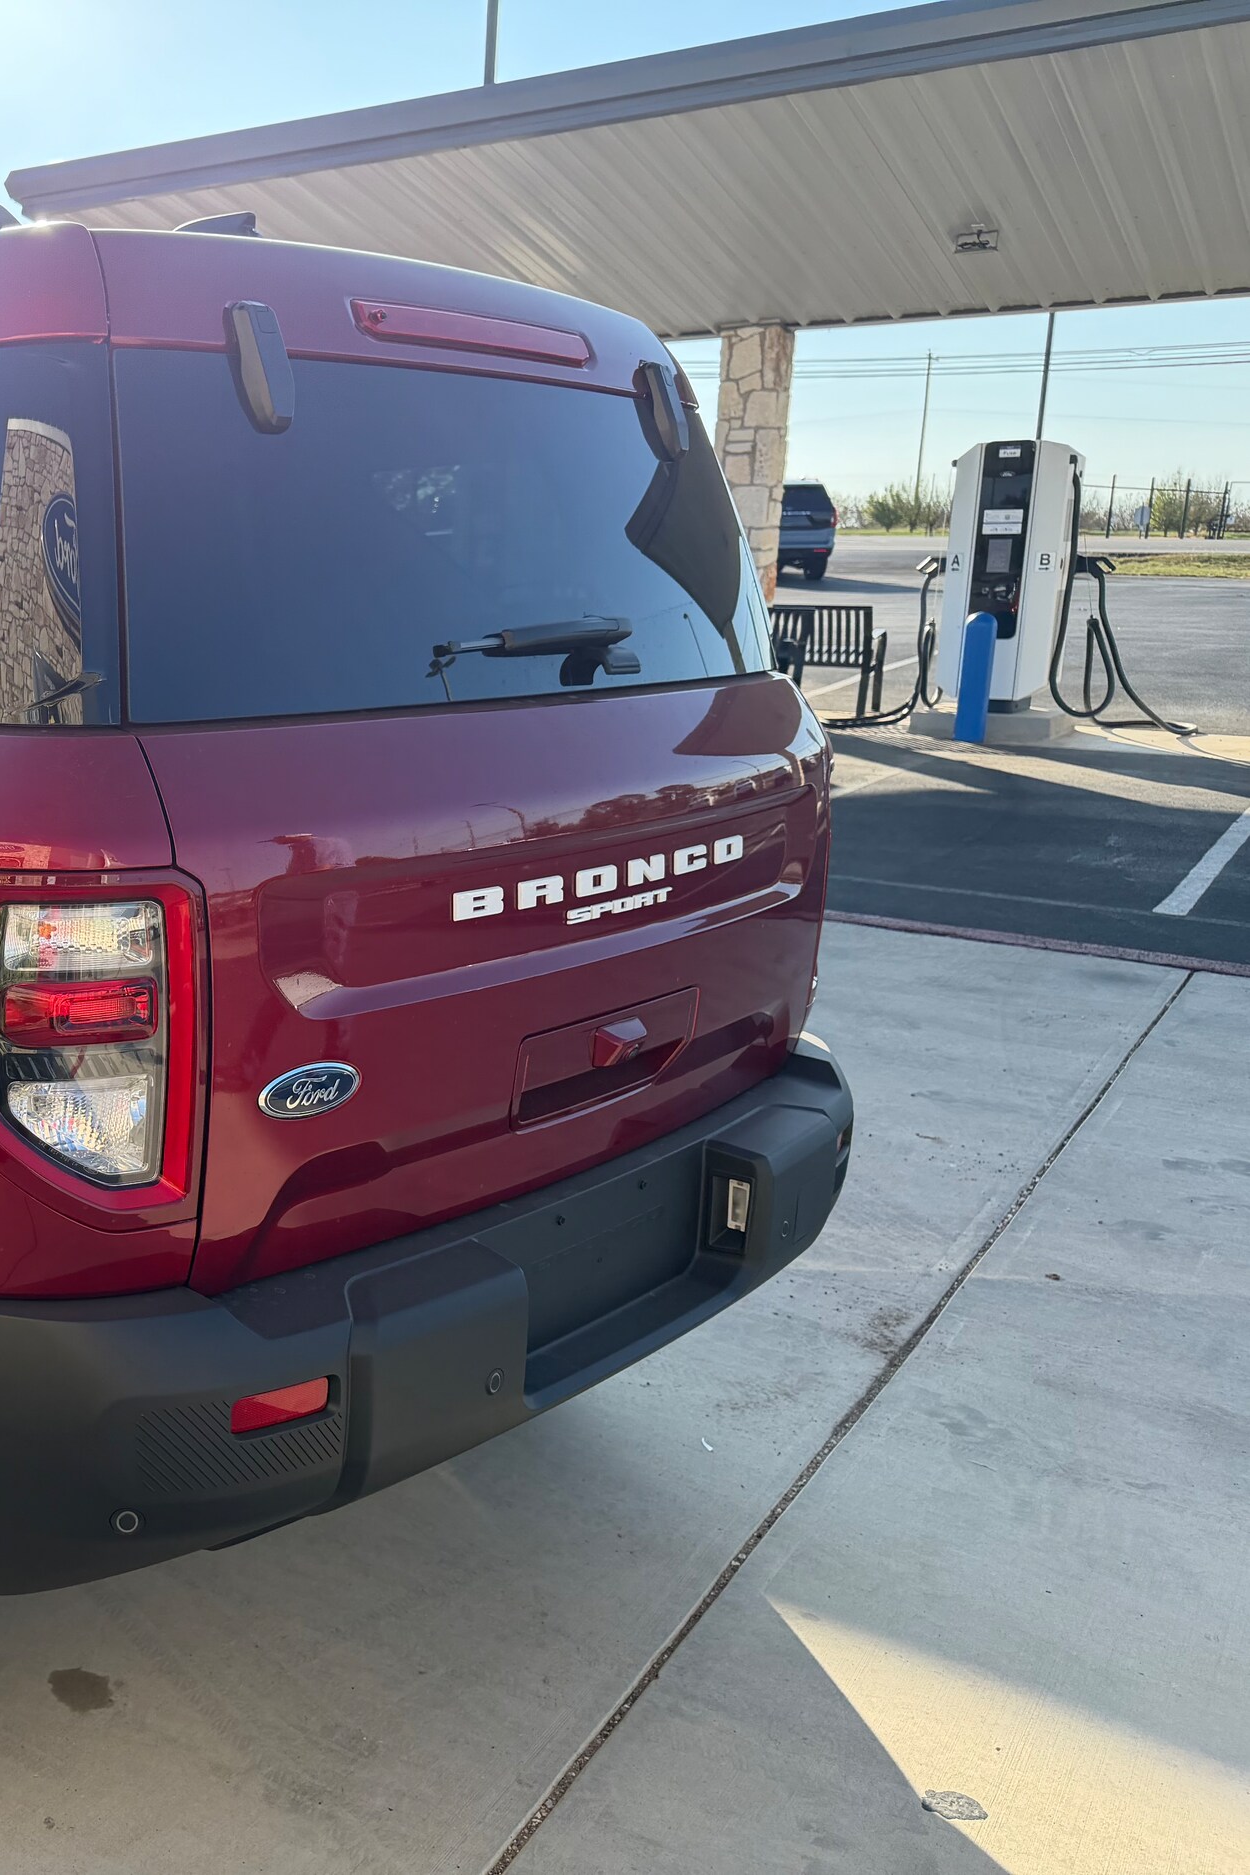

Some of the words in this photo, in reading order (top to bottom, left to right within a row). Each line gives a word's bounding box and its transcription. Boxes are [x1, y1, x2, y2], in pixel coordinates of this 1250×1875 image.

[951, 554, 960, 567] A
[1039, 553, 1051, 566] B
[453, 835, 743, 921] BRONCO
[566, 887, 673, 925] SPORT
[286, 1075, 340, 1109] Ford
